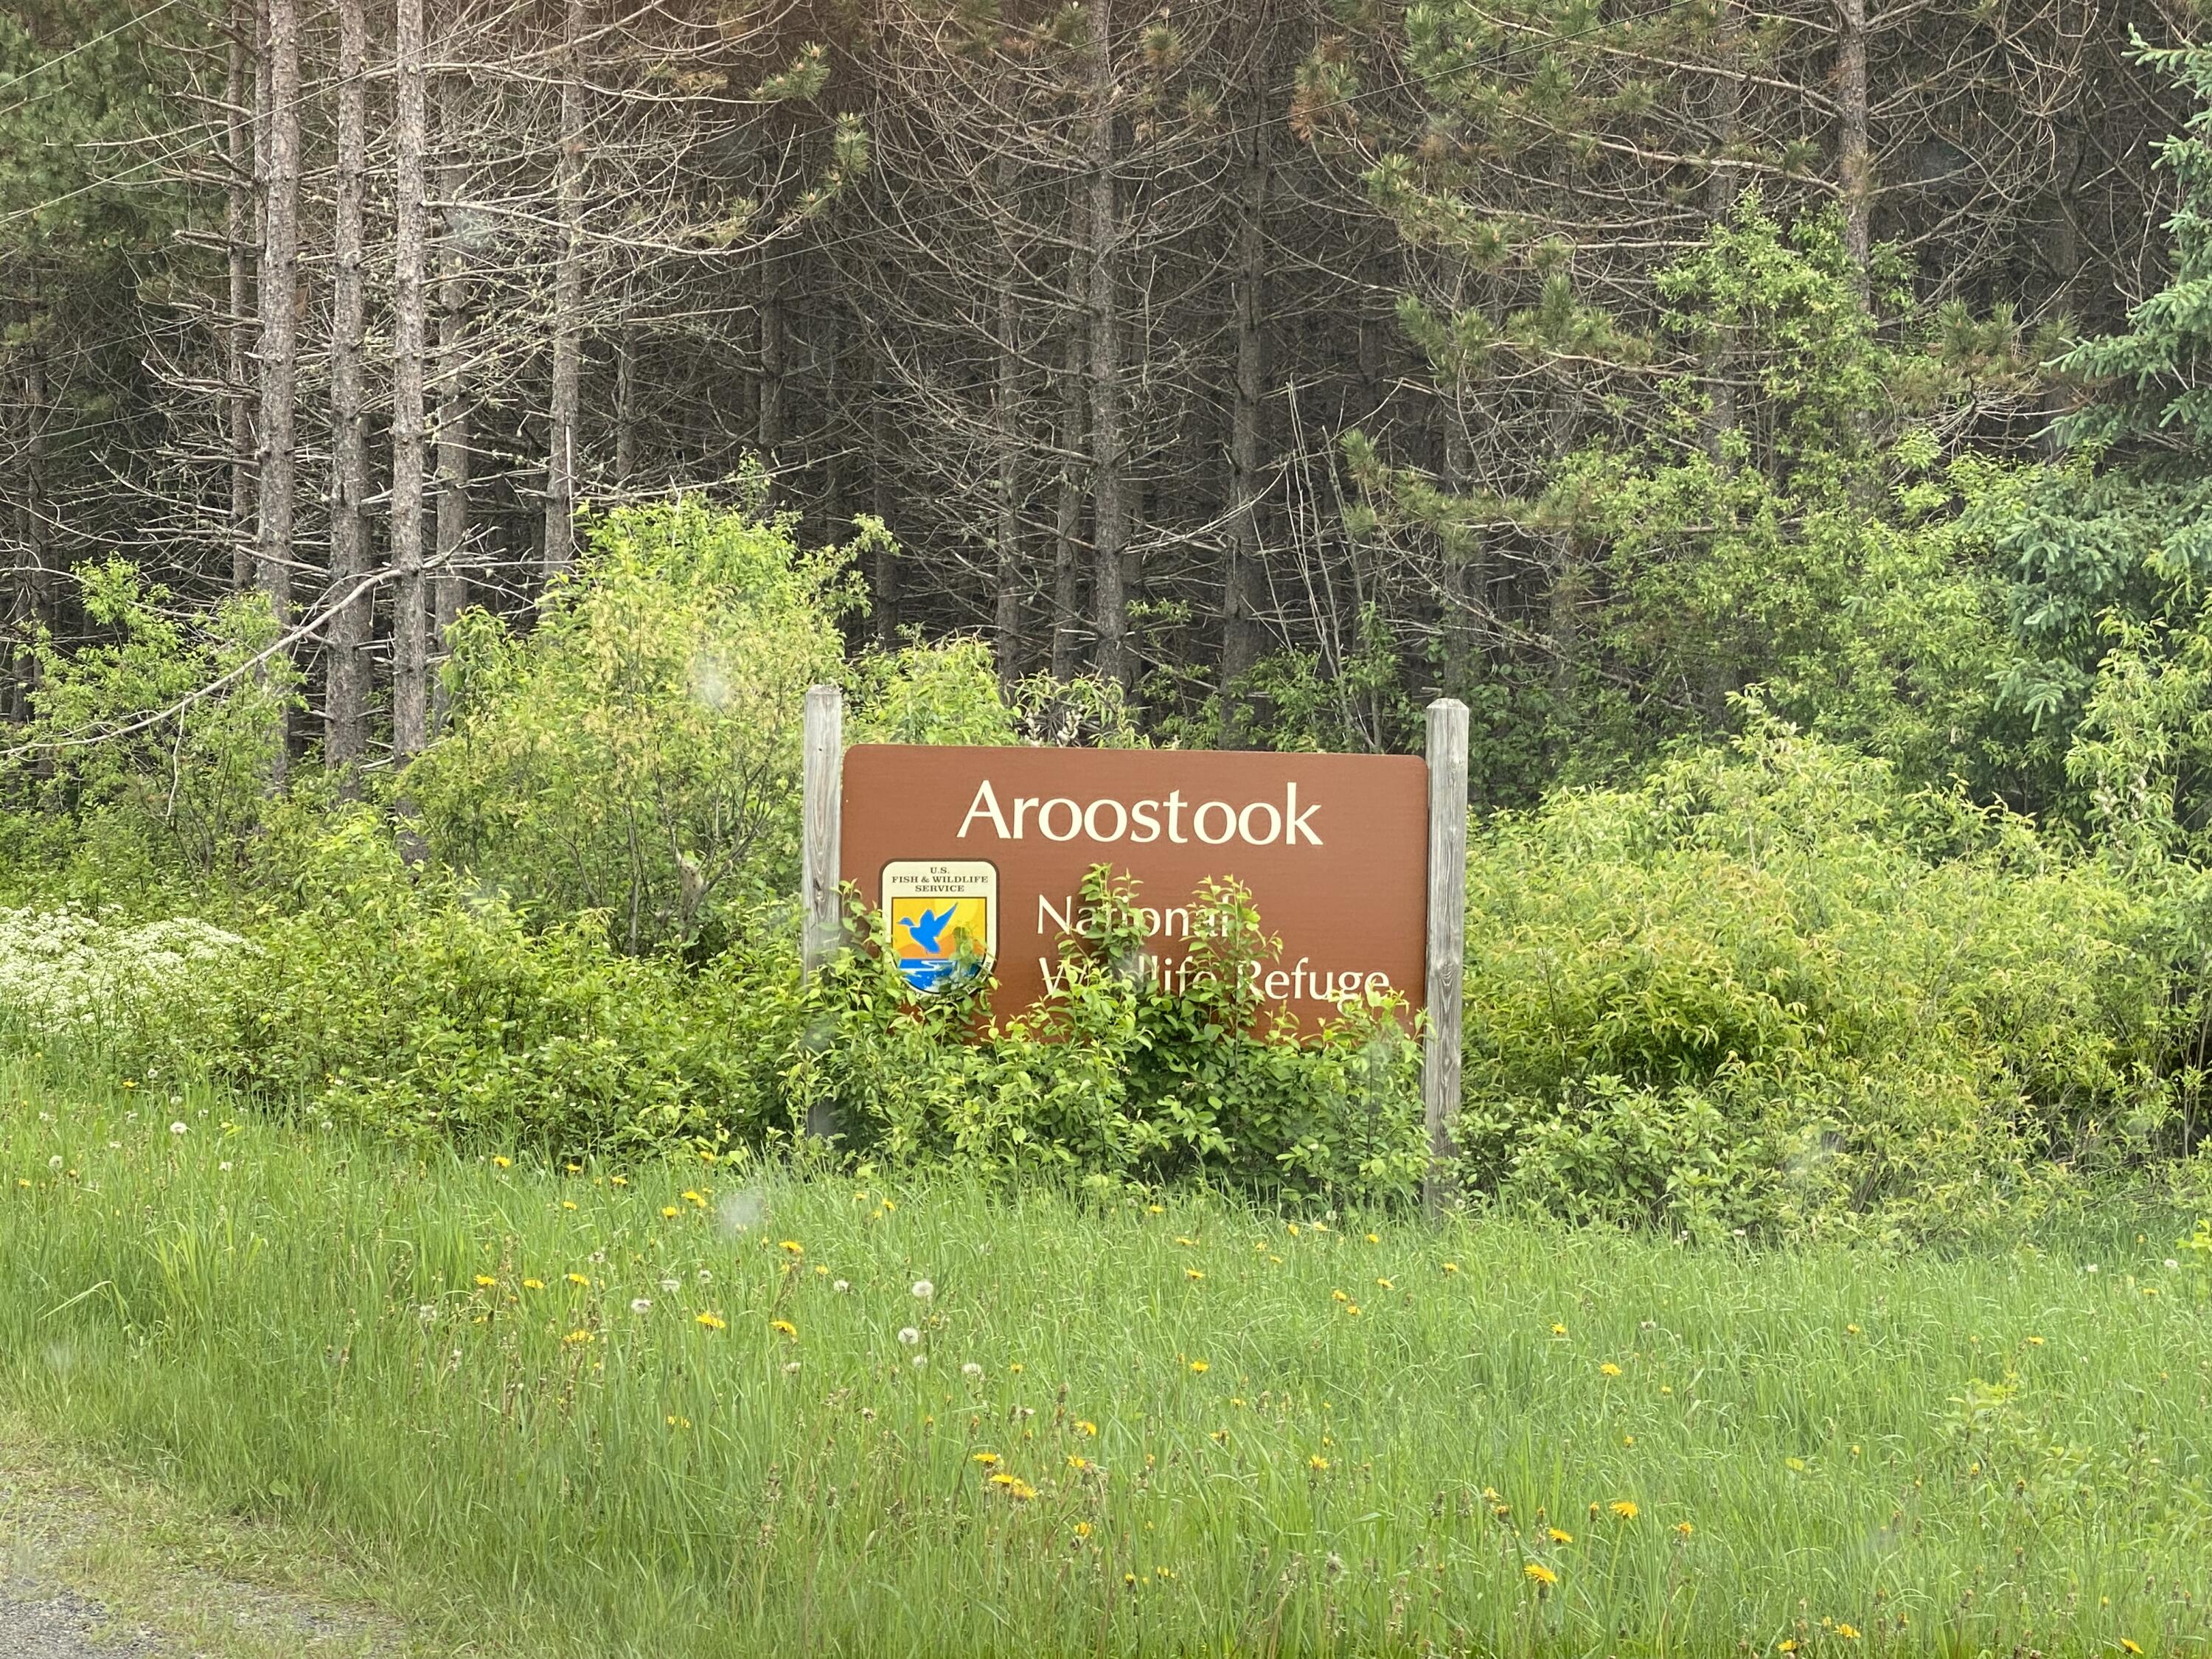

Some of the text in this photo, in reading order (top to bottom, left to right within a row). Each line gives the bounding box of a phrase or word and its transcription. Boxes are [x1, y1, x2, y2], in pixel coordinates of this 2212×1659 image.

[956, 779, 1324, 845] Aroostook
[931, 866, 950, 874] U.S.
[1038, 956, 1217, 998] Wlife
